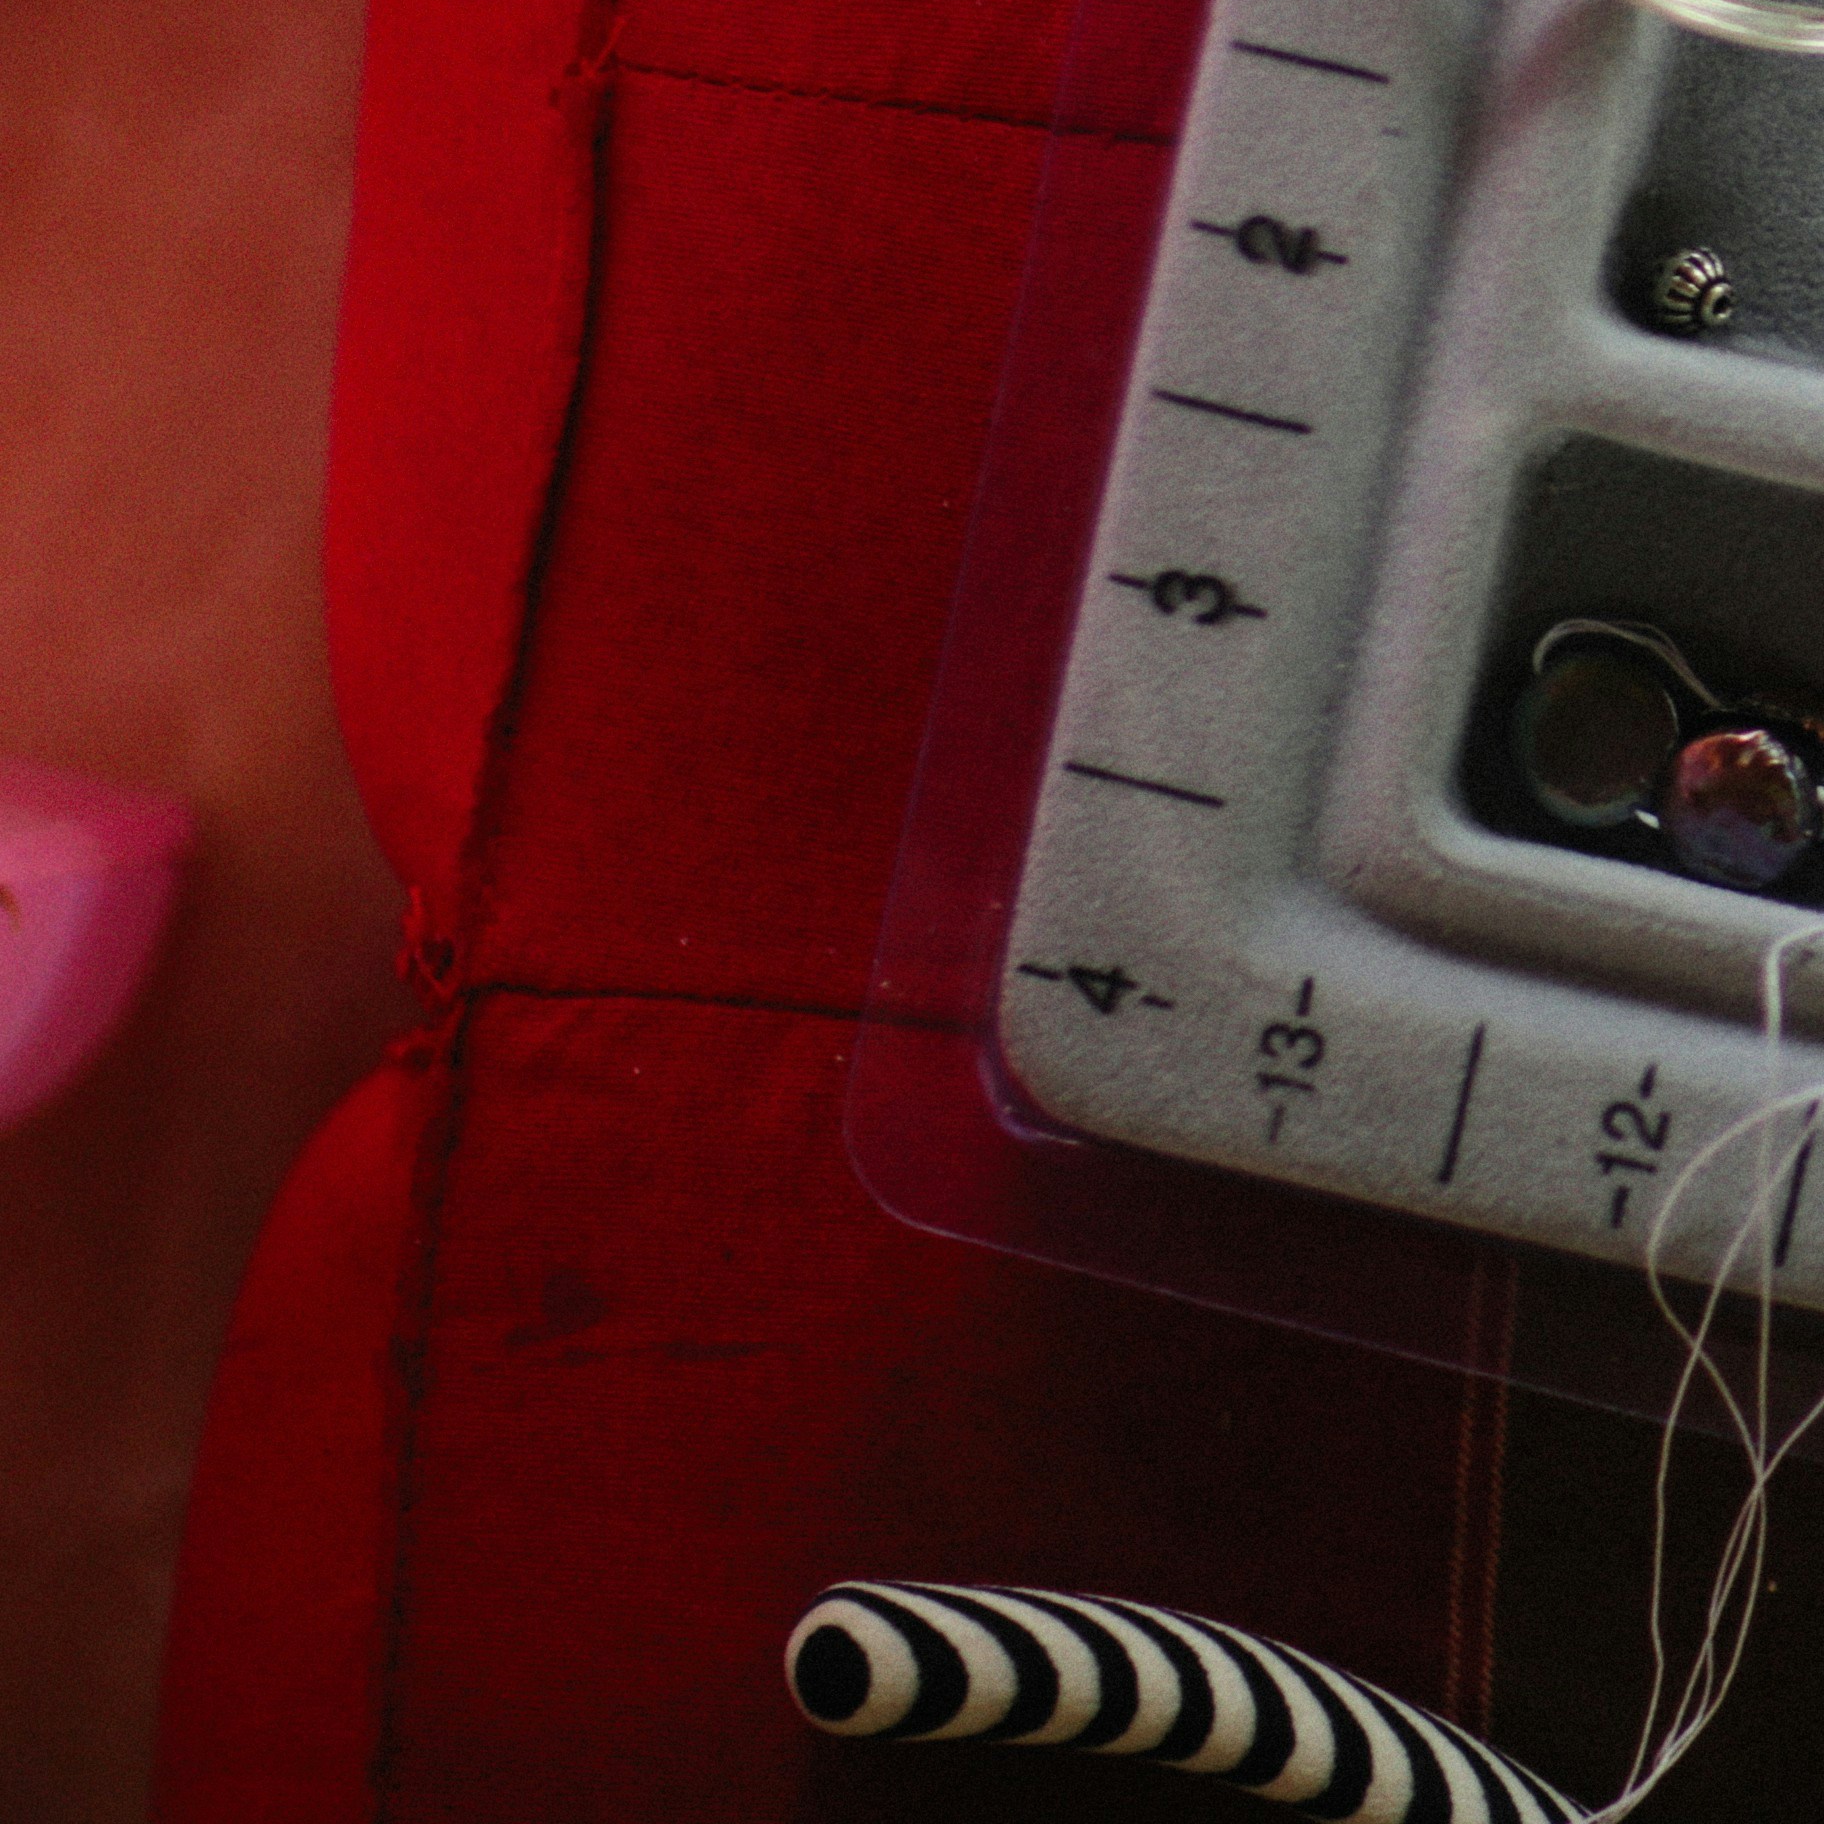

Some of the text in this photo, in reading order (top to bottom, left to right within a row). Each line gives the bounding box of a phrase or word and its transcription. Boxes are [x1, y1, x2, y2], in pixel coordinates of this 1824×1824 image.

[1234, 214, 1322, 276] 2
[1148, 568, 1234, 626] 3
[1064, 962, 1140, 1016] 4
[1255, 1021, 1326, 1094] 13
[1593, 1100, 1672, 1177] 12
